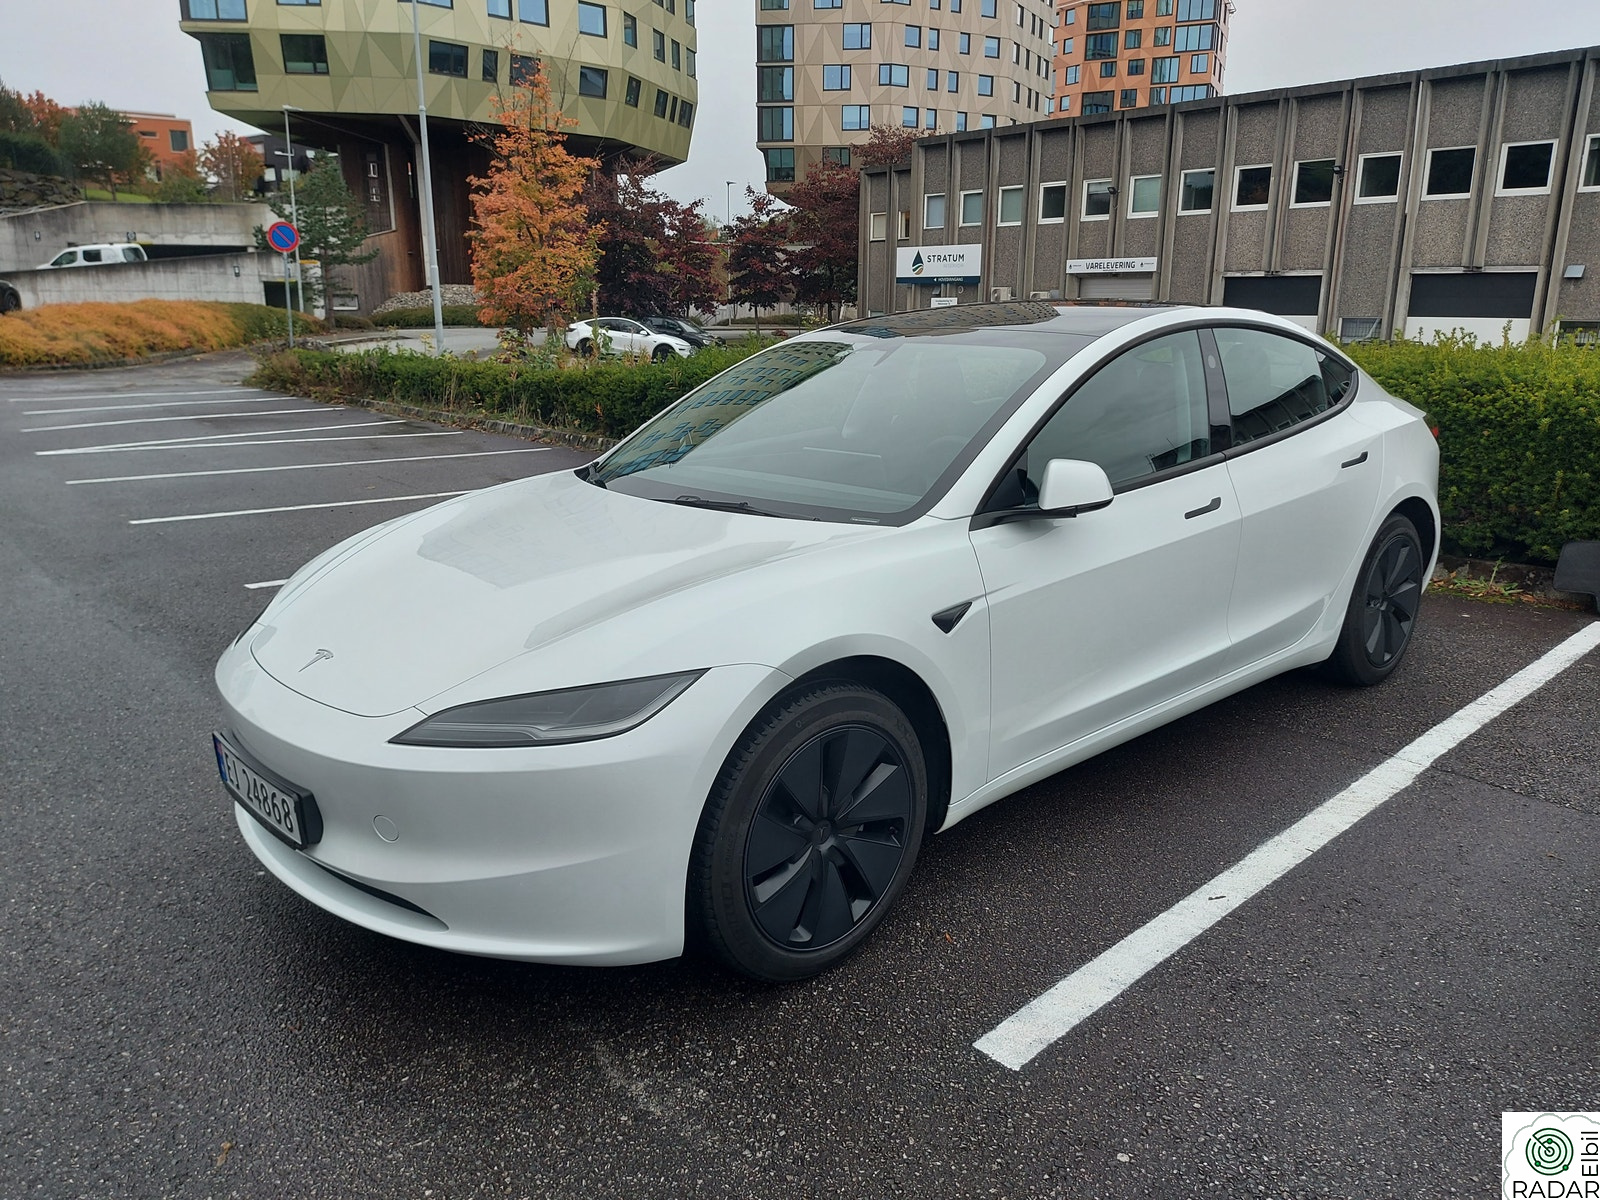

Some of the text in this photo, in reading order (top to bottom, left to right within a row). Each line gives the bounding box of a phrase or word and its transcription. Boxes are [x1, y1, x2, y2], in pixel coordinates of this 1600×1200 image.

[927, 254, 965, 263] STRATUM
[1085, 261, 1136, 270] VARELEVERING
[242, 768, 294, 833] 24868
